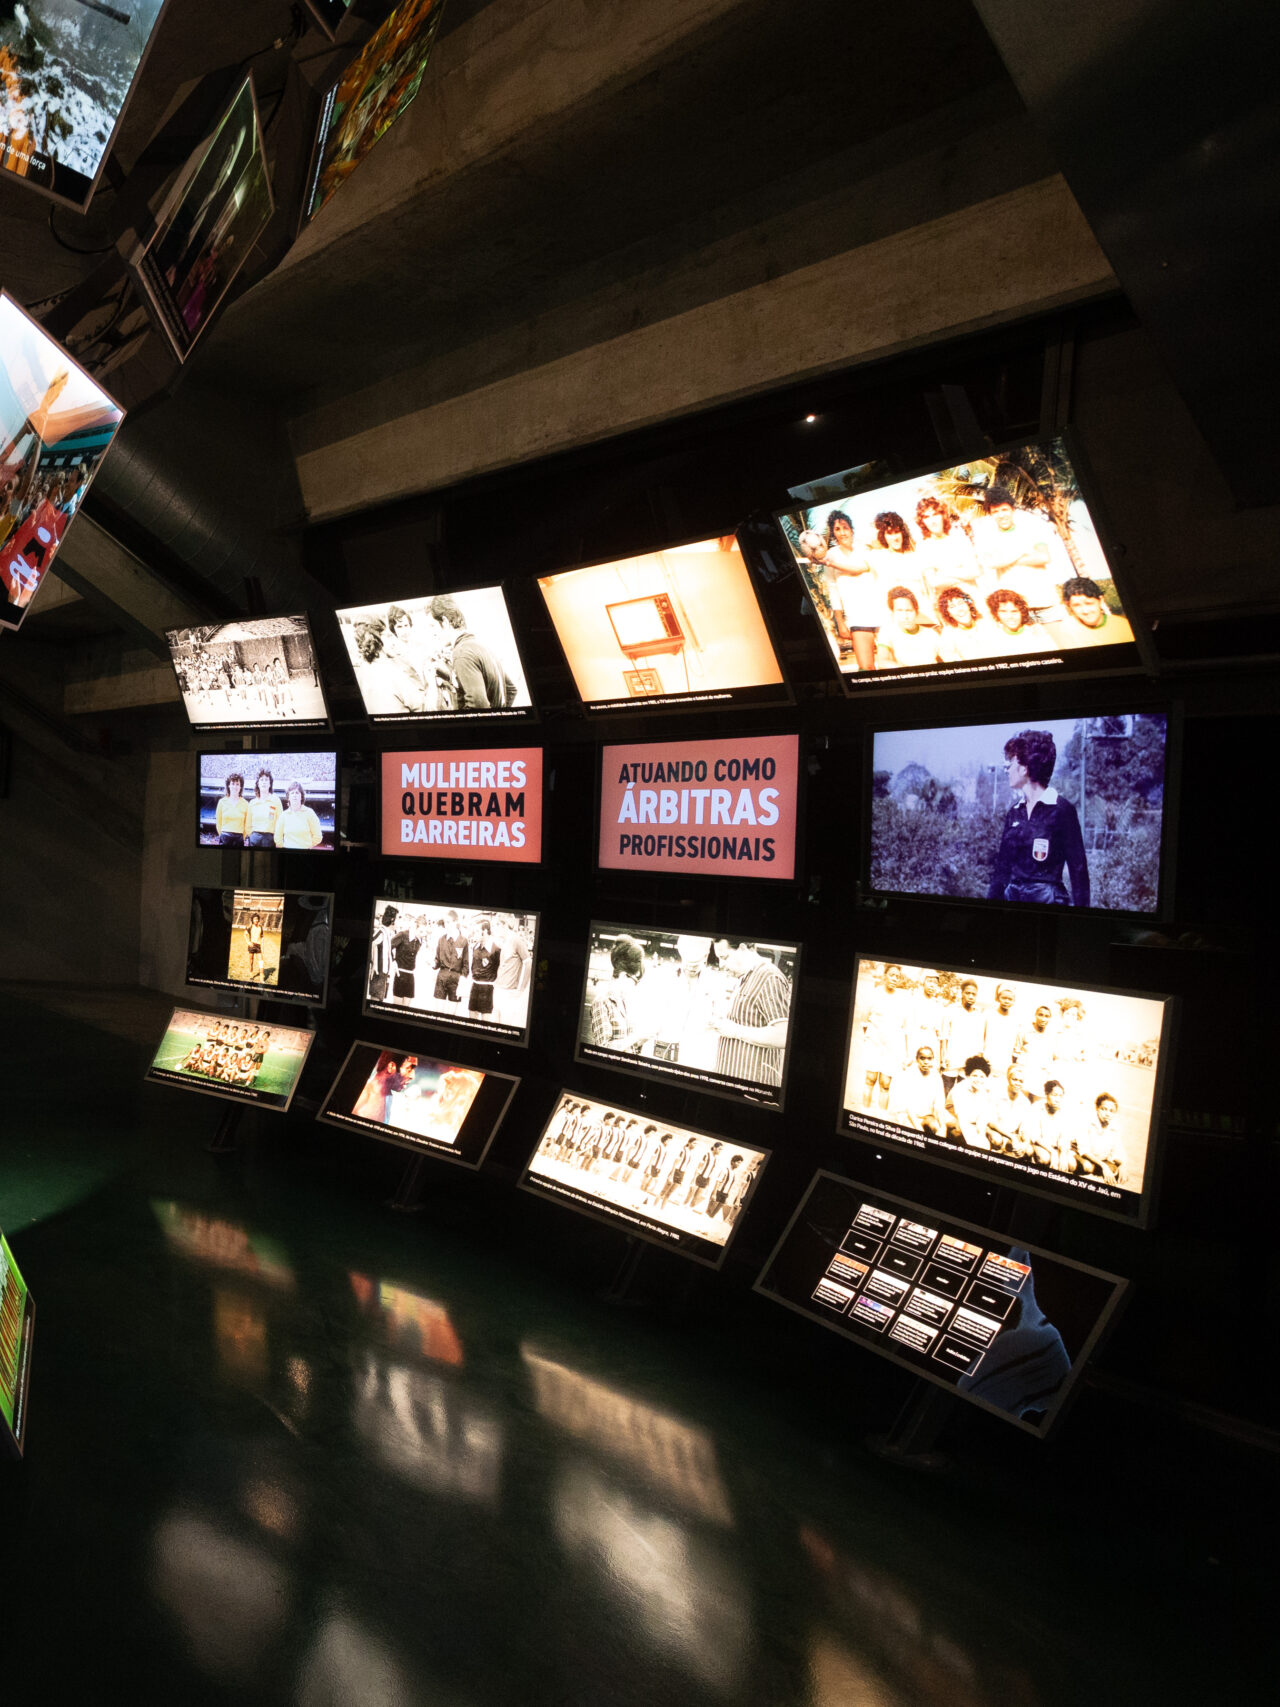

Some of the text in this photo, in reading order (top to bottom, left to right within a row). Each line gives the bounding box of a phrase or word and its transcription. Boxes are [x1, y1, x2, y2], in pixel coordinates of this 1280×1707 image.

[6, 145, 15, 154] de
[15, 152, 29, 162] uma
[30, 156, 46, 170] força
[401, 761, 526, 788] MULHERES
[619, 757, 775, 783] ATUANDO COMO
[402, 792, 524, 817] QUEBRAM
[618, 781, 780, 826] ÁRBITRAS
[401, 820, 526, 848] BARREIRAS
[619, 833, 776, 861] PROFISSIONAIS
